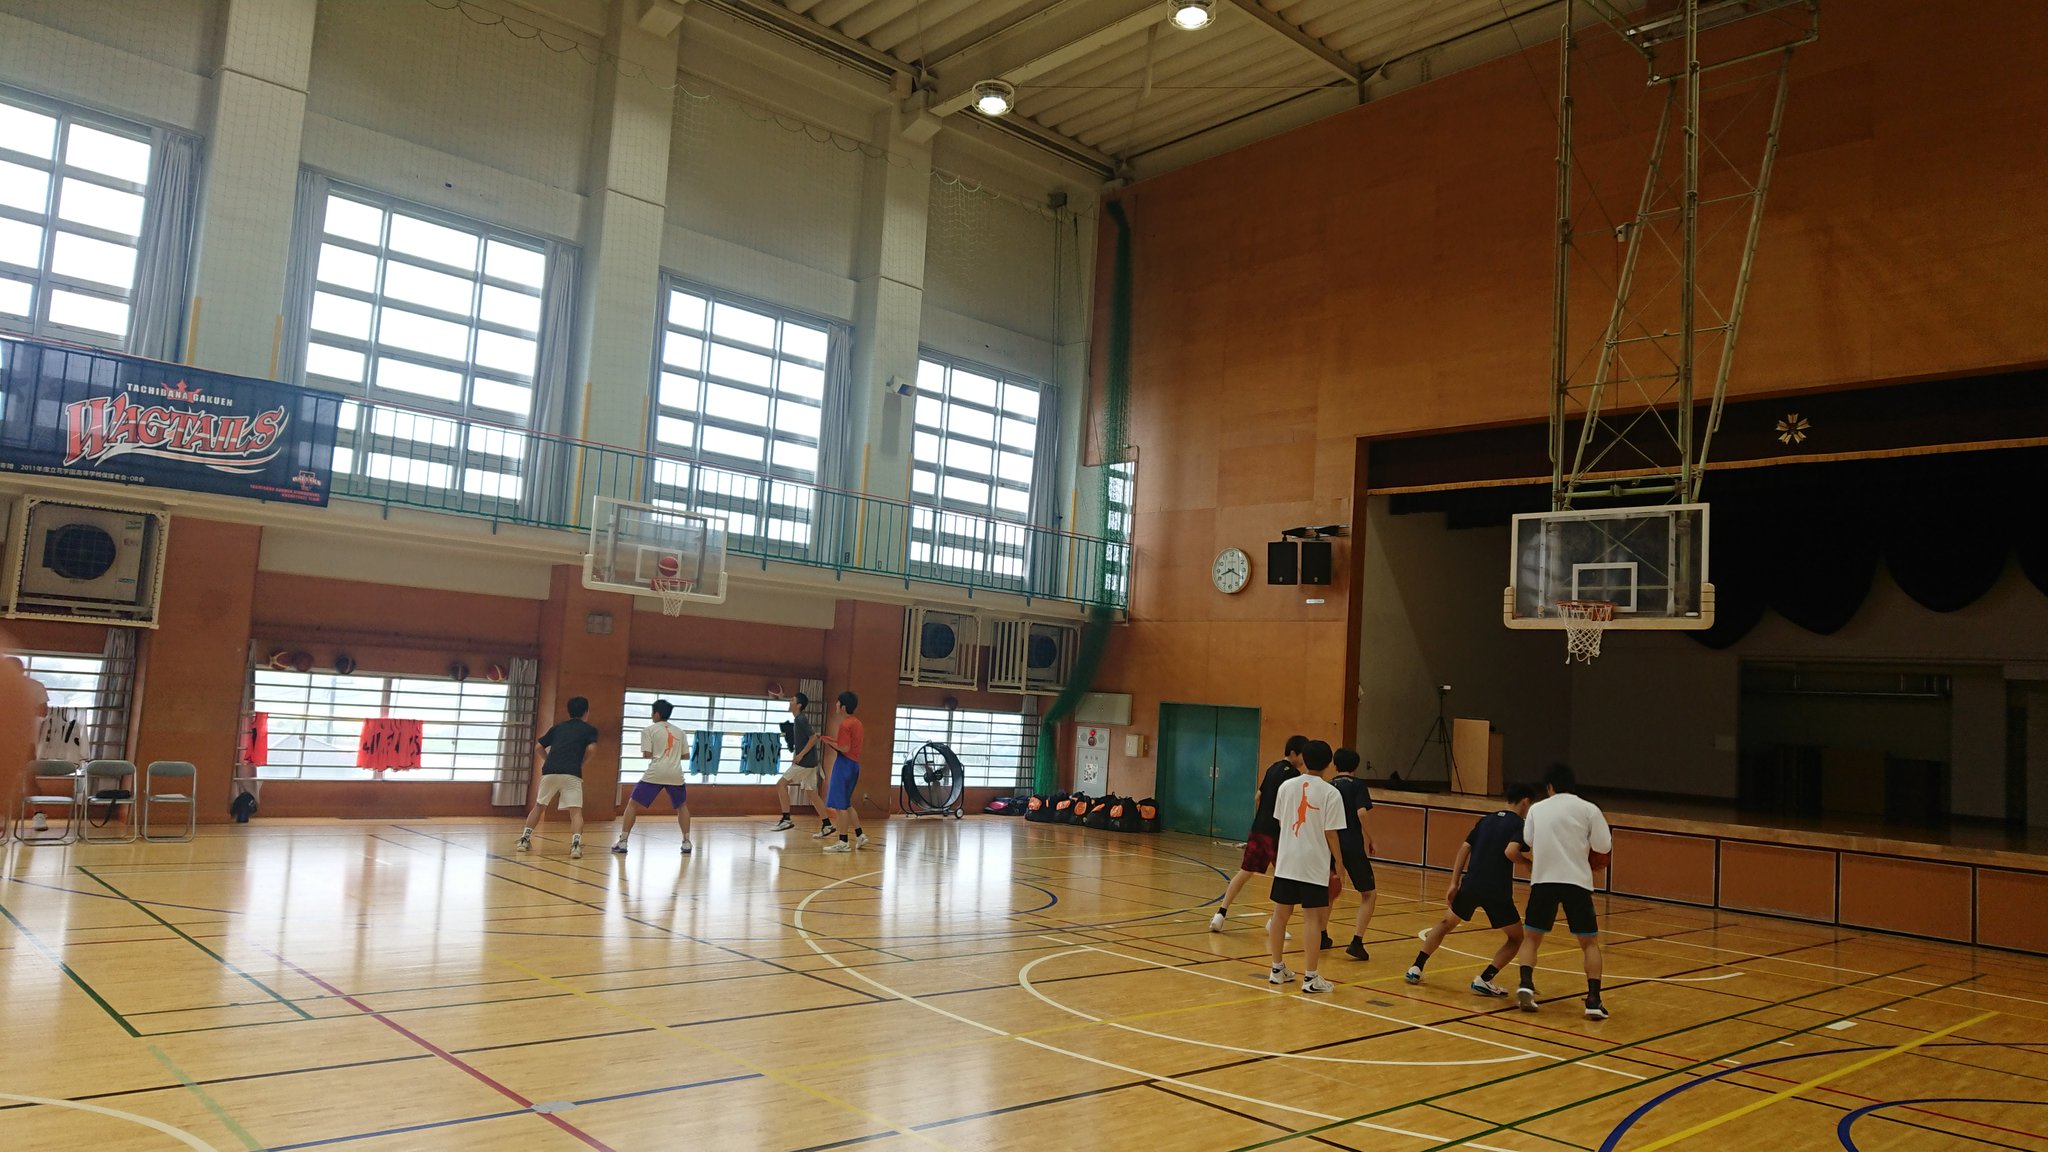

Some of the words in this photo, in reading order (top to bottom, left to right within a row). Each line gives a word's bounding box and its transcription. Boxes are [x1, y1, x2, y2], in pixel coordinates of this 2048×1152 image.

[126, 382, 189, 400] TACHIBANA
[192, 393, 234, 407] GAKUEN
[63, 391, 286, 467] WAGTAILS
